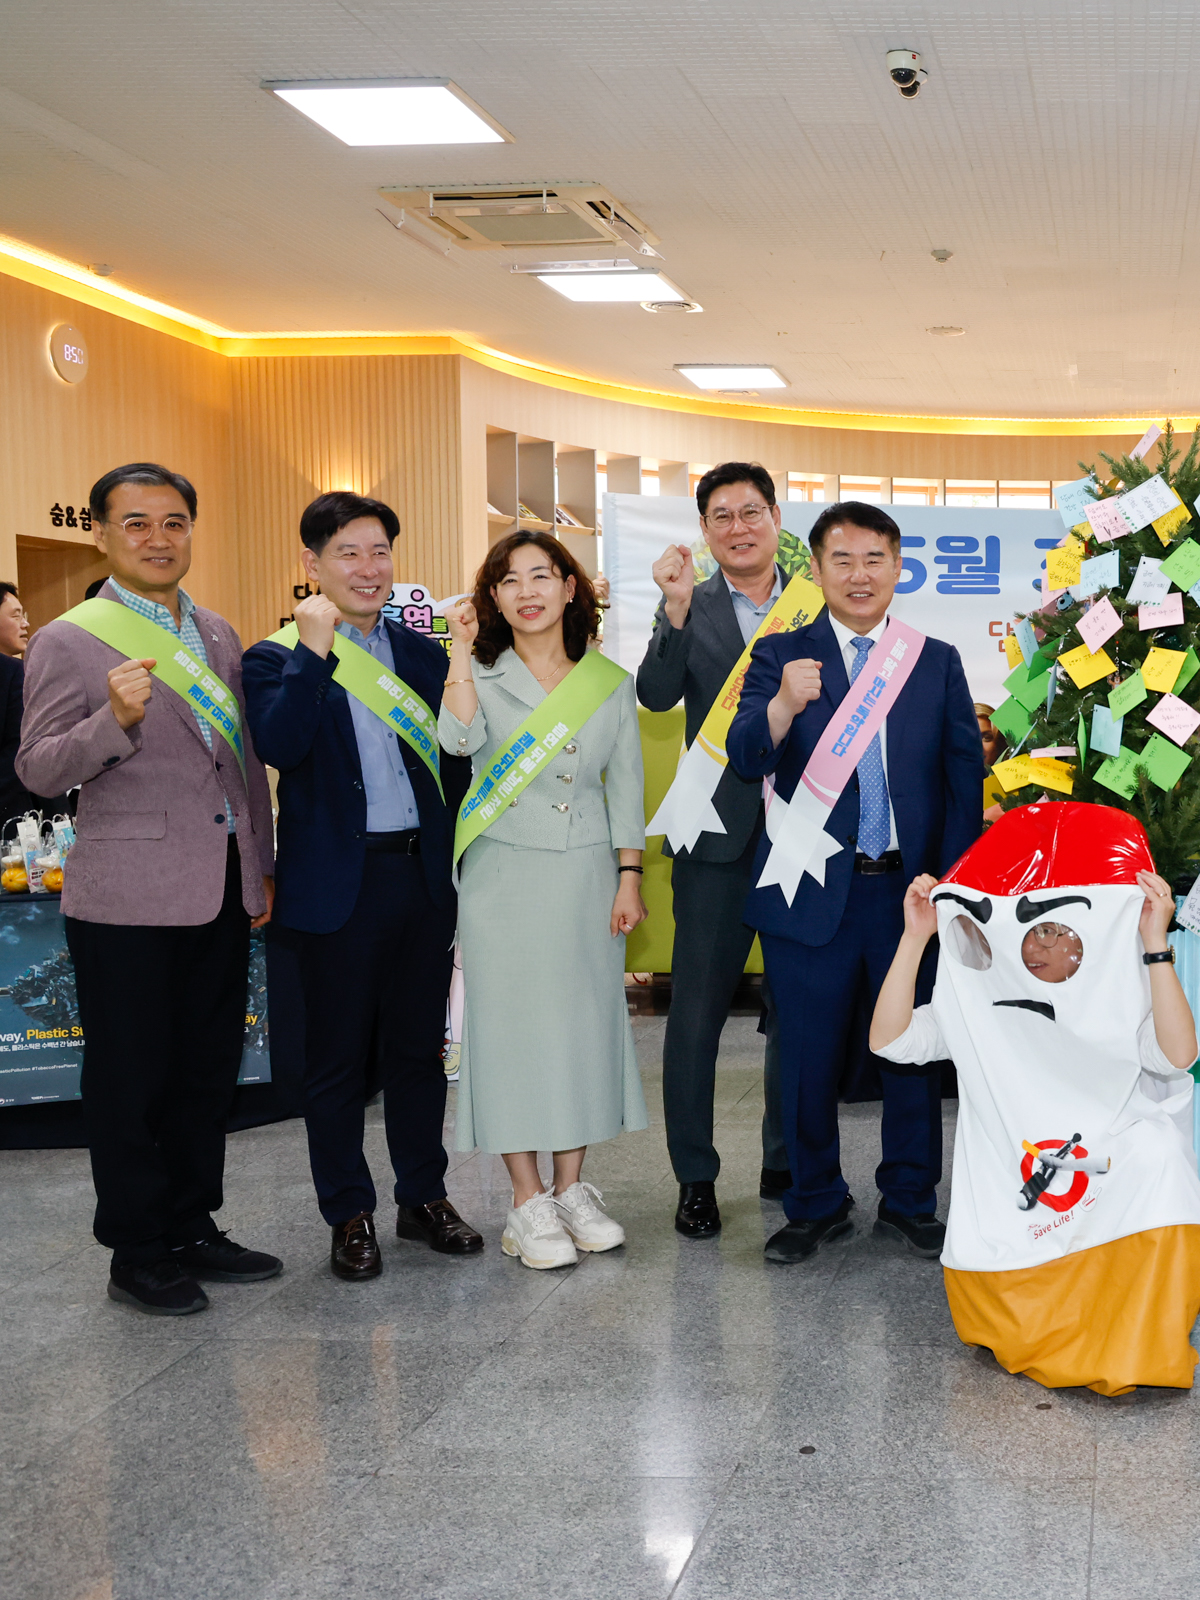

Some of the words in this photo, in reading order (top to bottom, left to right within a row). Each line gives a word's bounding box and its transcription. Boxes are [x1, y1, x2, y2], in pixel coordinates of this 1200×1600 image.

[890, 637, 908, 662] 담배
[173, 650, 202, 678] 흡연
[878, 657, 898, 681] 알고
[376, 674, 405, 700] 흡연
[862, 676, 887, 708] 마시는
[542, 721, 569, 750] 흡연
[830, 704, 870, 757] 독약입니다
[490, 731, 536, 780] 쾌락뒤의
[518, 746, 547, 775] 뒤에
[497, 770, 523, 798] 남은
[479, 794, 502, 821] 것은
[12, 1043, 41, 1051] 플라스틱은
[42, 1041, 59, 1049] 수백년
[26, 1027, 69, 1040] Plastic
[1033, 1223, 1052, 1239] Save
